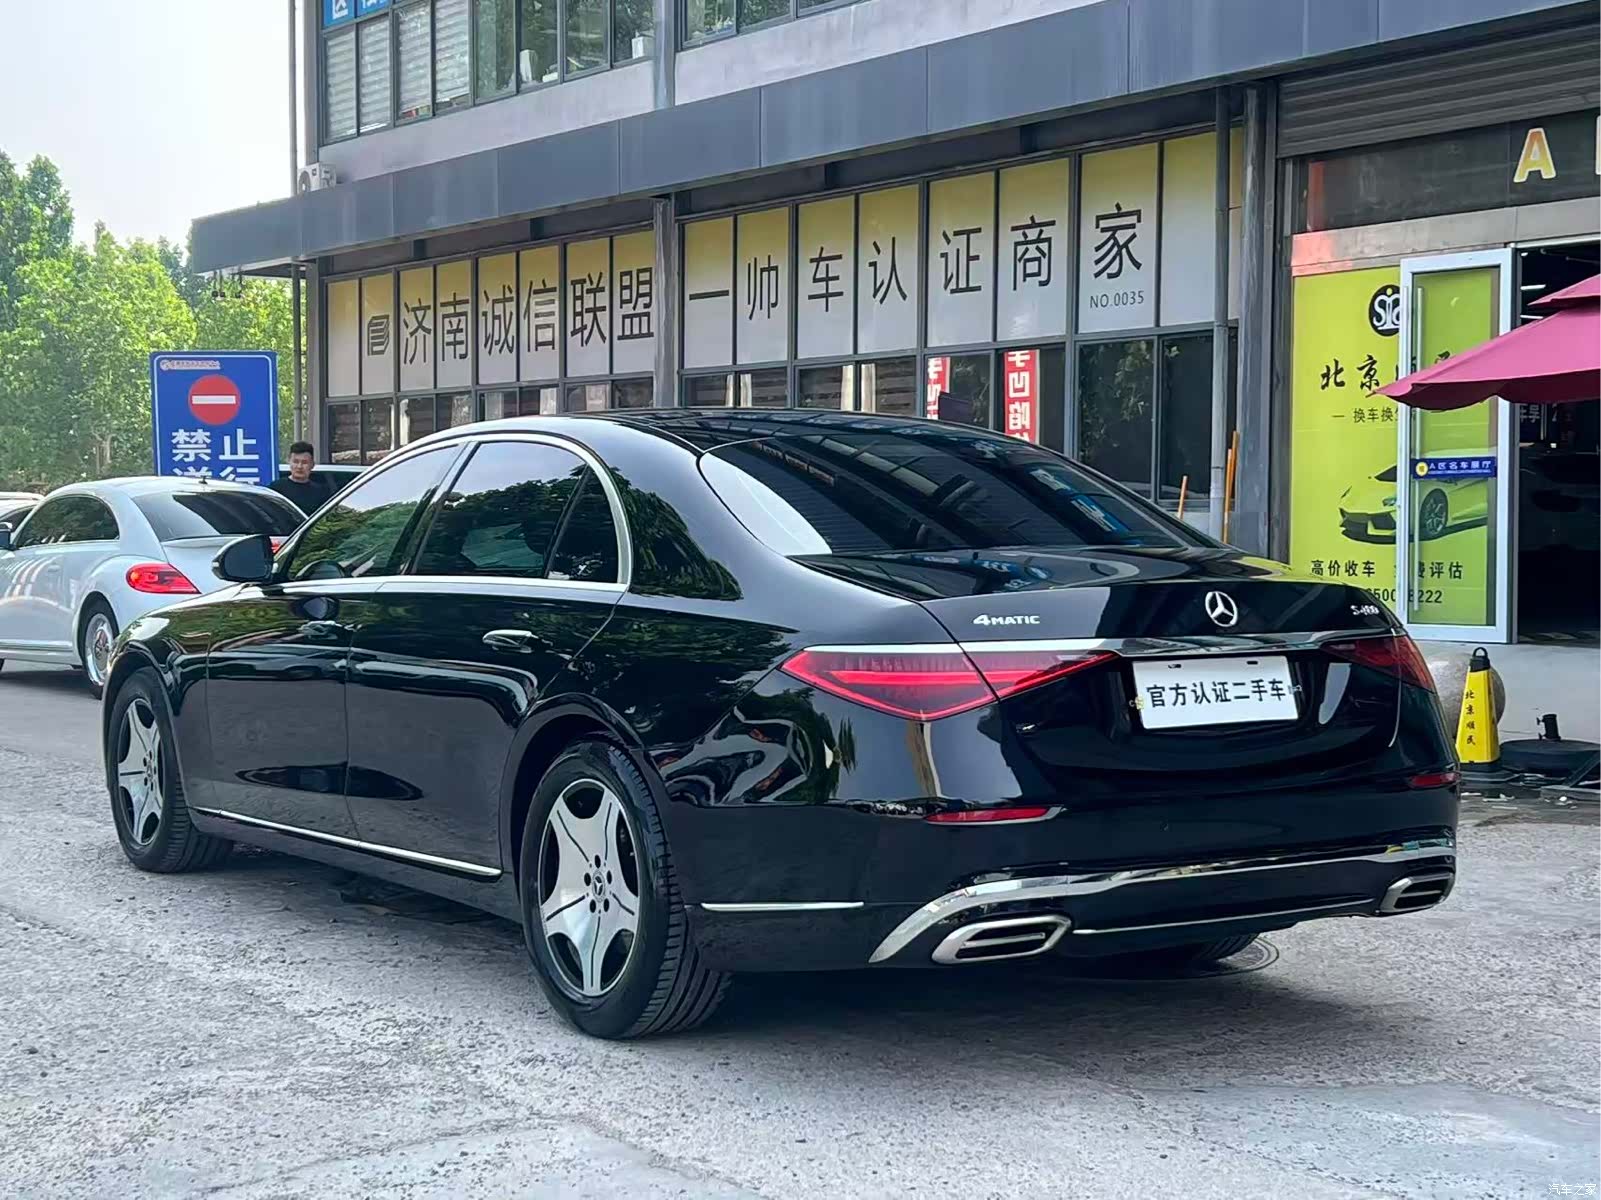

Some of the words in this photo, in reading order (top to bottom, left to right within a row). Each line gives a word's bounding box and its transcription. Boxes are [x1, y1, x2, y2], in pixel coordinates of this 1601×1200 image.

[403, 266, 655, 366] 济南诚信联盟
[688, 202, 1143, 322] 一帅车认证商家
[1089, 290, 1146, 309] NO.0035
[1353, 408, 1399, 424] 换车换
[171, 428, 260, 462] 禁止
[1311, 559, 1376, 577] 高价收车
[973, 614, 1041, 626] 4MATIC
[1147, 678, 1287, 708] 官方认证二手车
